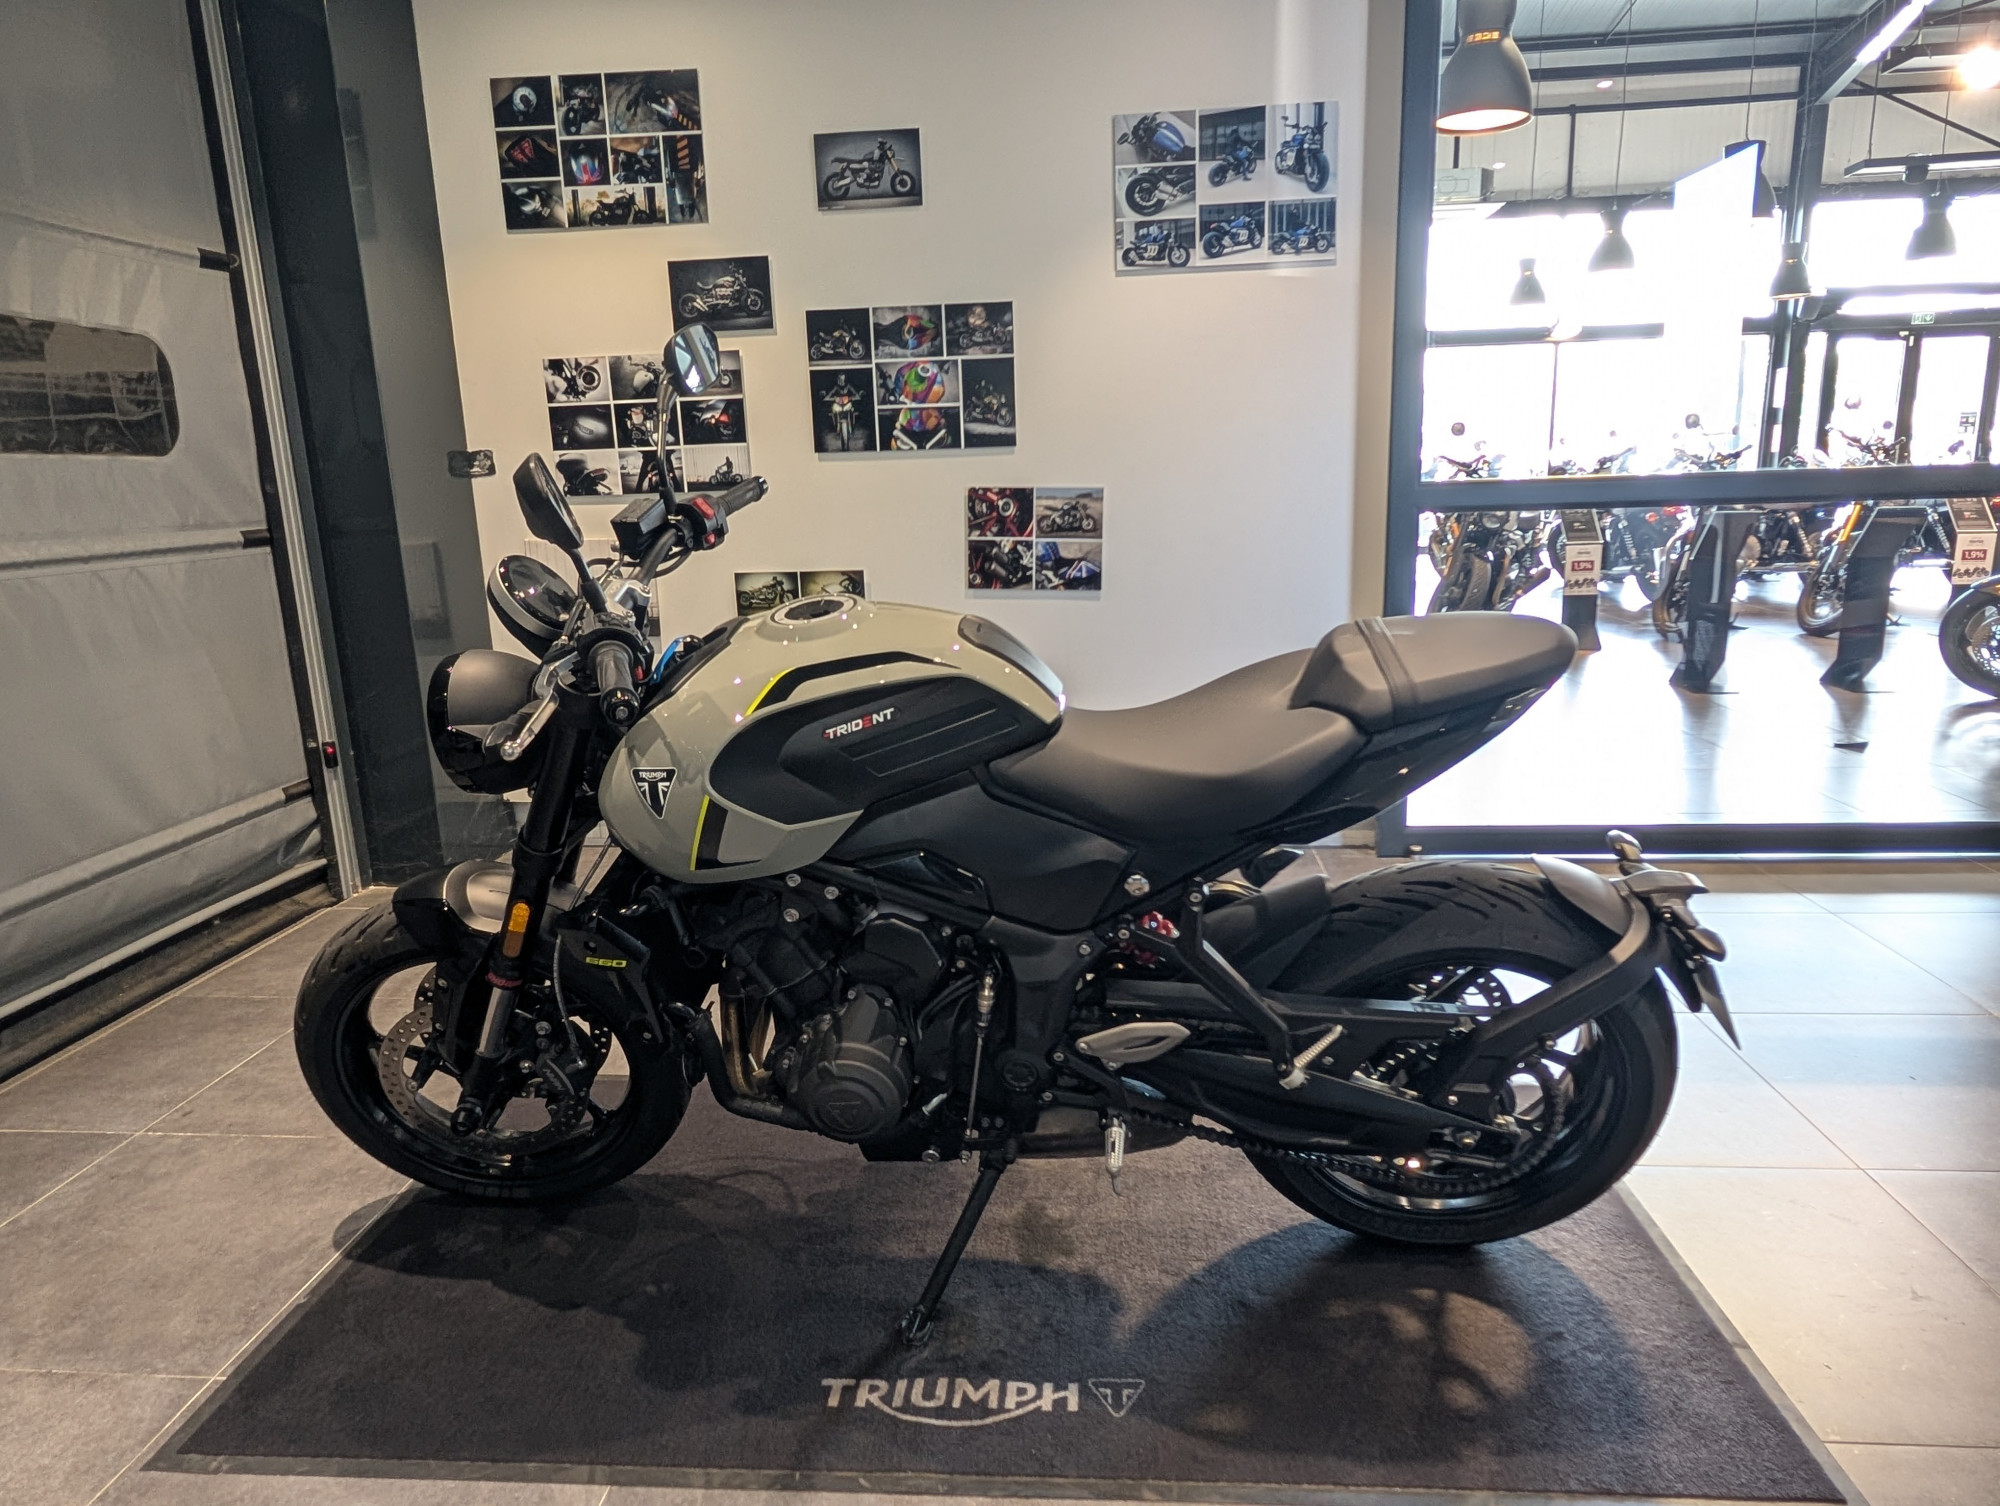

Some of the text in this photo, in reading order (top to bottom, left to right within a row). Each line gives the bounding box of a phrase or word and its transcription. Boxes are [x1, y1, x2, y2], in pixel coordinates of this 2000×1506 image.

[822, 707, 895, 739] TRIDENT
[638, 771, 667, 781] TRIUMPH
[585, 956, 627, 968] 660
[821, 1376, 1079, 1427] TRIUMPH
